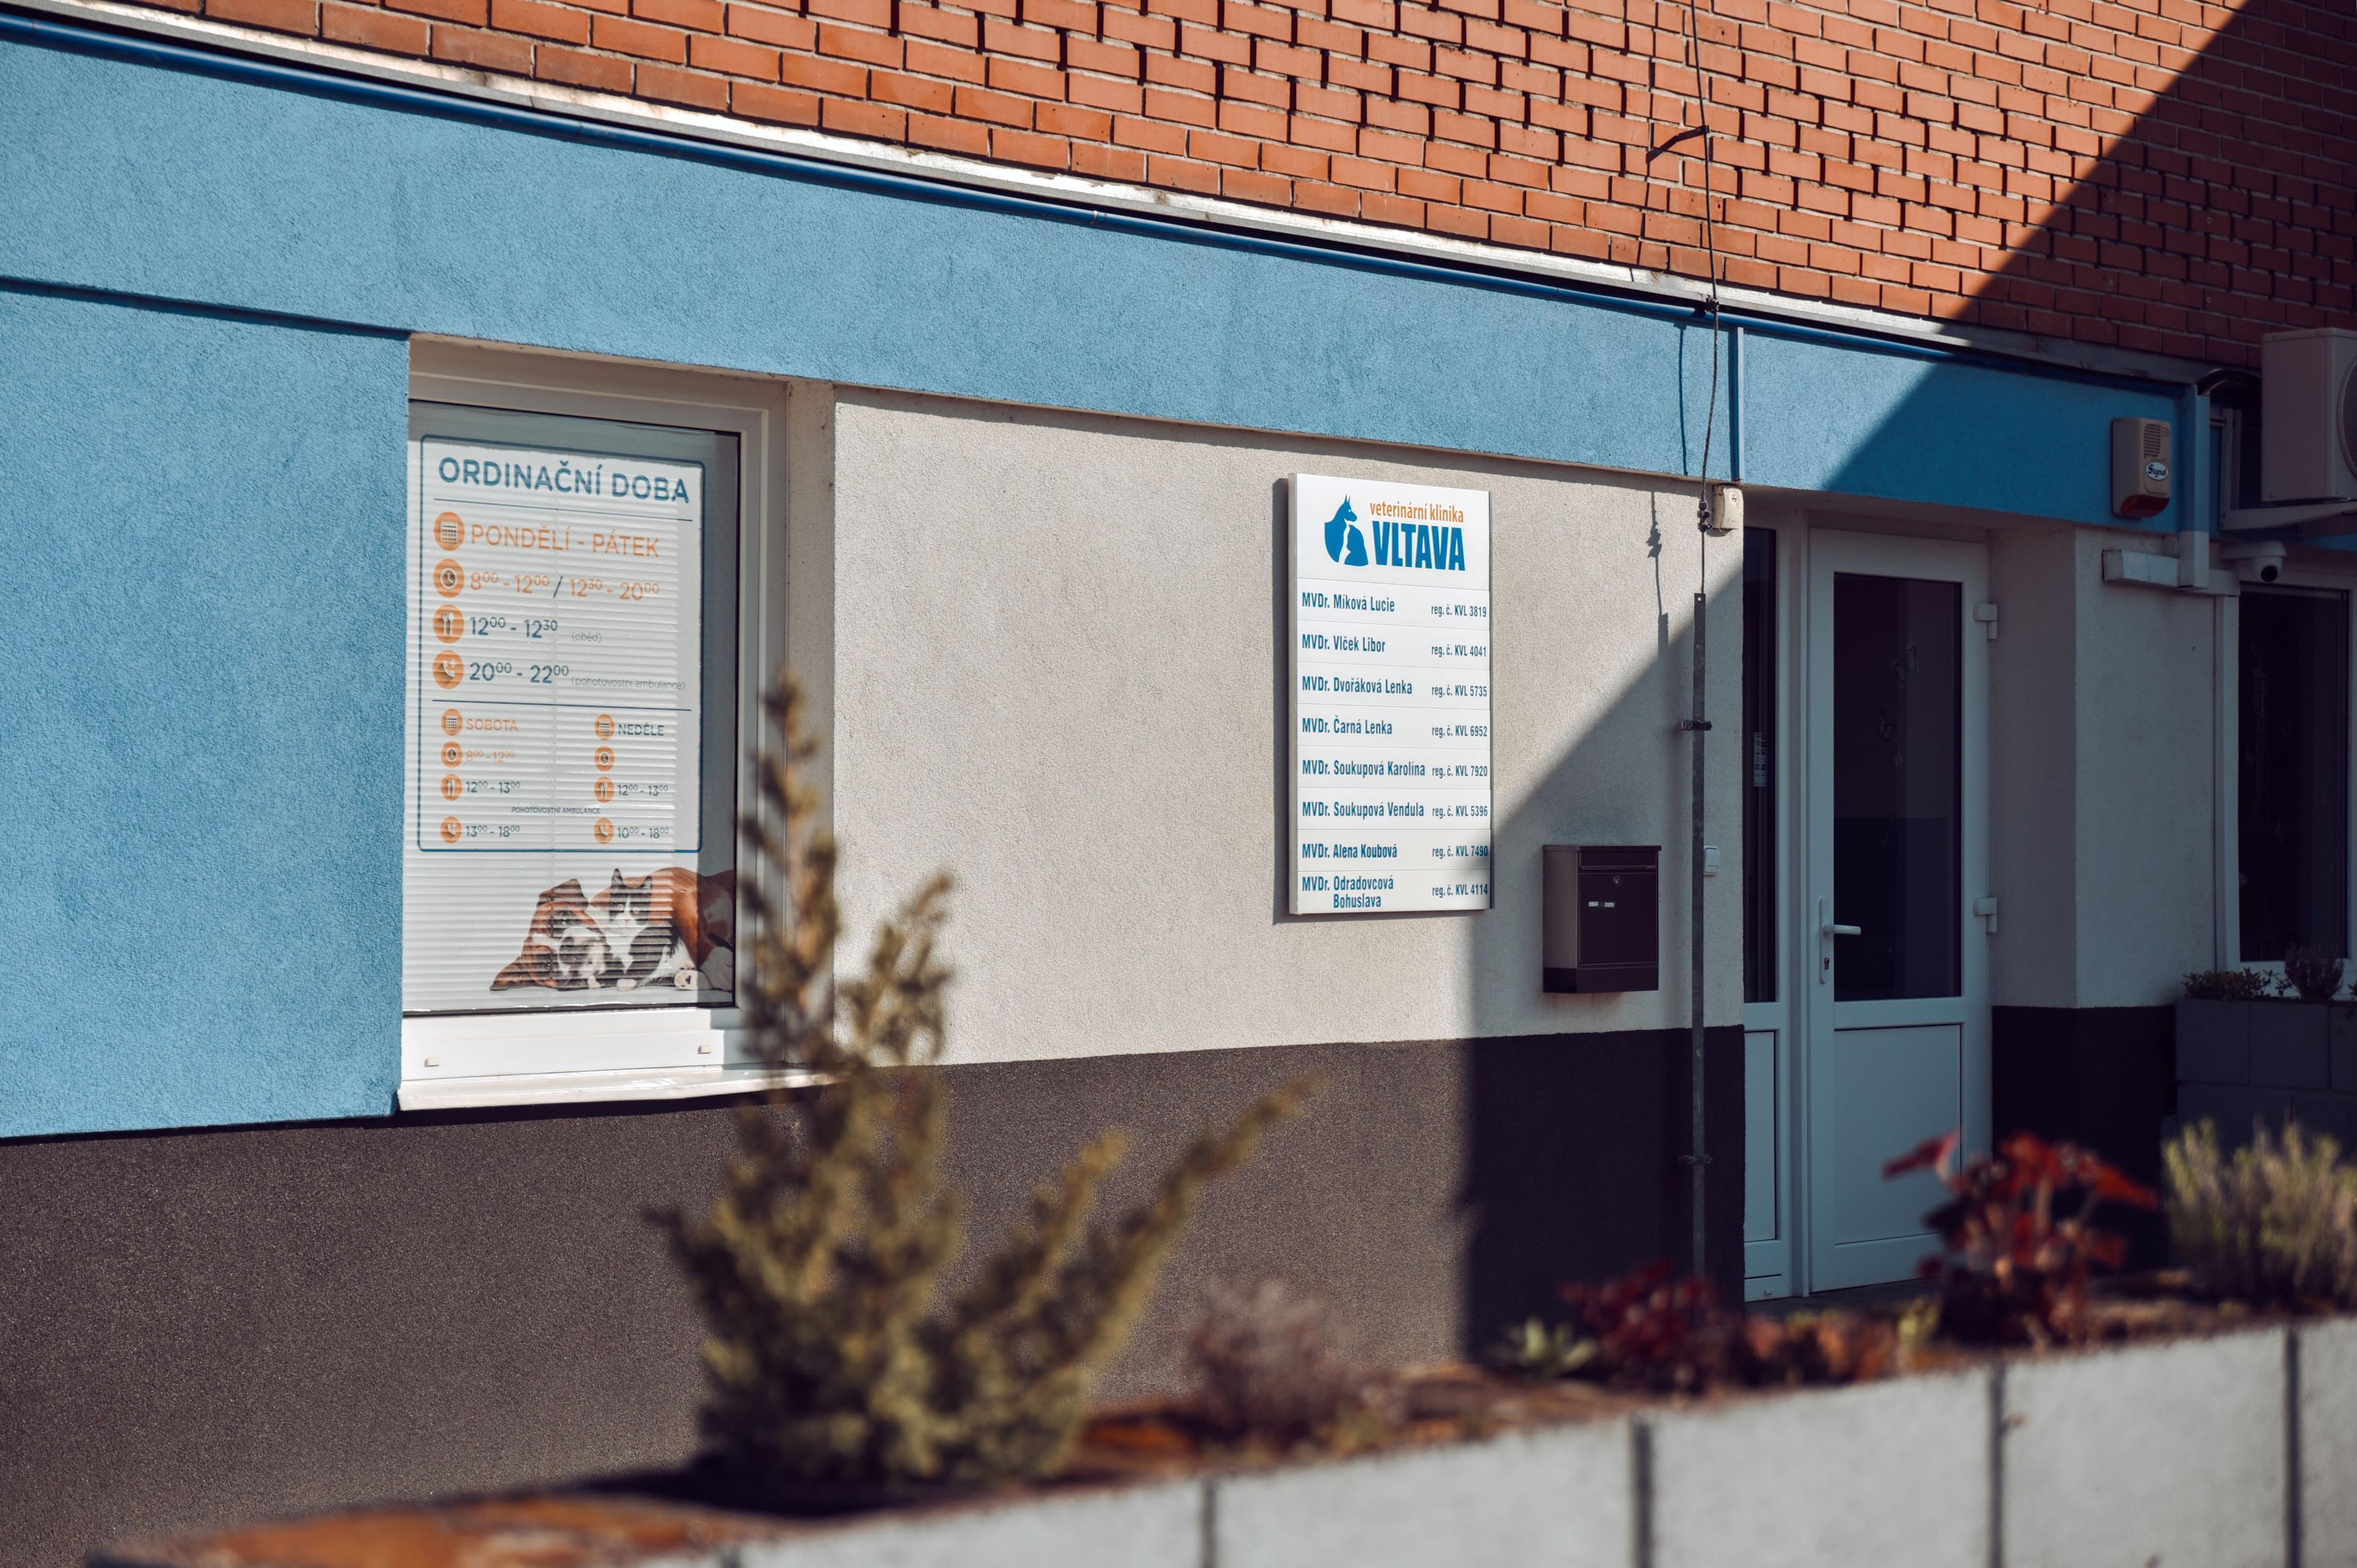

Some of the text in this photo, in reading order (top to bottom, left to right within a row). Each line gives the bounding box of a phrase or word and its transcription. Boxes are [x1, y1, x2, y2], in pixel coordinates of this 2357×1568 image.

[438, 457, 689, 503] ORDINAČNÍ DOBA
[2148, 464, 2167, 477] Signal
[1369, 501, 1464, 523] veterinární klinika
[470, 524, 570, 552] PONDĚLÍ
[593, 530, 659, 557] PÁTEK
[1372, 521, 1465, 571] VLTAVA
[1302, 592, 1487, 618] MVDr. Míková Lucie reg. č. KVL 3819
[1302, 633, 1486, 658] MVDr. Vlček Libor reg. č. KVL 4041
[635, 678, 685, 691] ambulance)
[1302, 676, 1487, 698] MVDr. Dvořáková Lenka reg. č. KVL 5735
[466, 718, 518, 732] SOBOTA
[618, 722, 664, 737] NEDĚLE
[1302, 715, 1488, 739] MVDr. Čarná Lenka reg. č. KVL 6952
[1302, 760, 1488, 779] MVDr. Soukupová Karolína reg. č. KVL 7920
[511, 806, 600, 815] POHOTOVOSTNÍ AMBULANCE
[1302, 801, 1488, 820] MVDr. Soukupová Vendula reg. č. KVL 5396
[1302, 843, 1488, 860] MVDr. Alena Koubová reg. č. KVL 7490
[1302, 876, 1394, 892] MVDr. Odradovcová
[1432, 884, 1488, 899] reg. č. KVL 4114
[1333, 893, 1381, 909] Bohuslava
